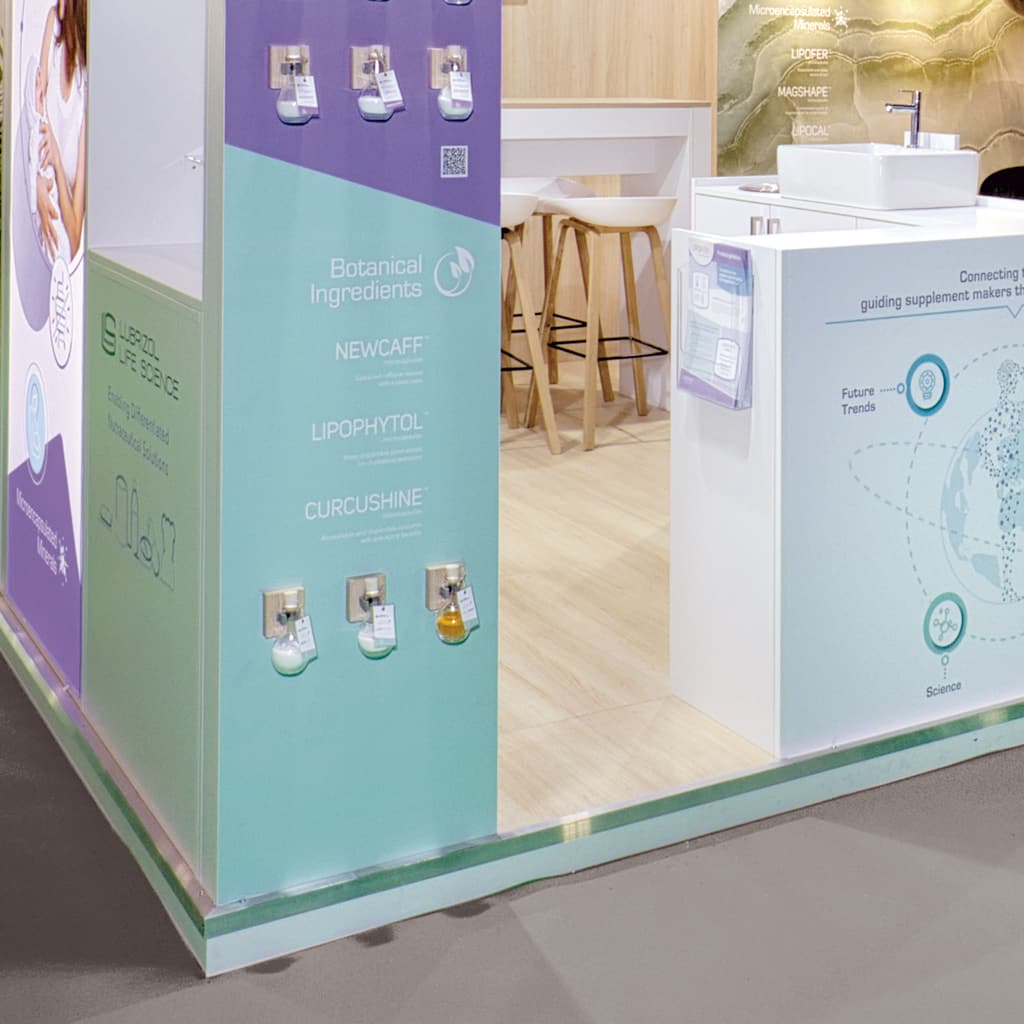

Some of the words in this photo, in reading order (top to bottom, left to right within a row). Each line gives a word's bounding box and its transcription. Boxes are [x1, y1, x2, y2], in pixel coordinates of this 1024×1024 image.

[791, 48, 829, 60] LIPOFER
[331, 255, 422, 279] Botanical
[960, 267, 1019, 283] Connecting
[311, 280, 422, 308] Ingredients
[860, 294, 902, 313] guiding
[905, 289, 970, 308] supplement
[973, 285, 1012, 300] makers
[842, 387, 875, 400] Future
[841, 401, 876, 415] Trends
[926, 682, 962, 698] Science
